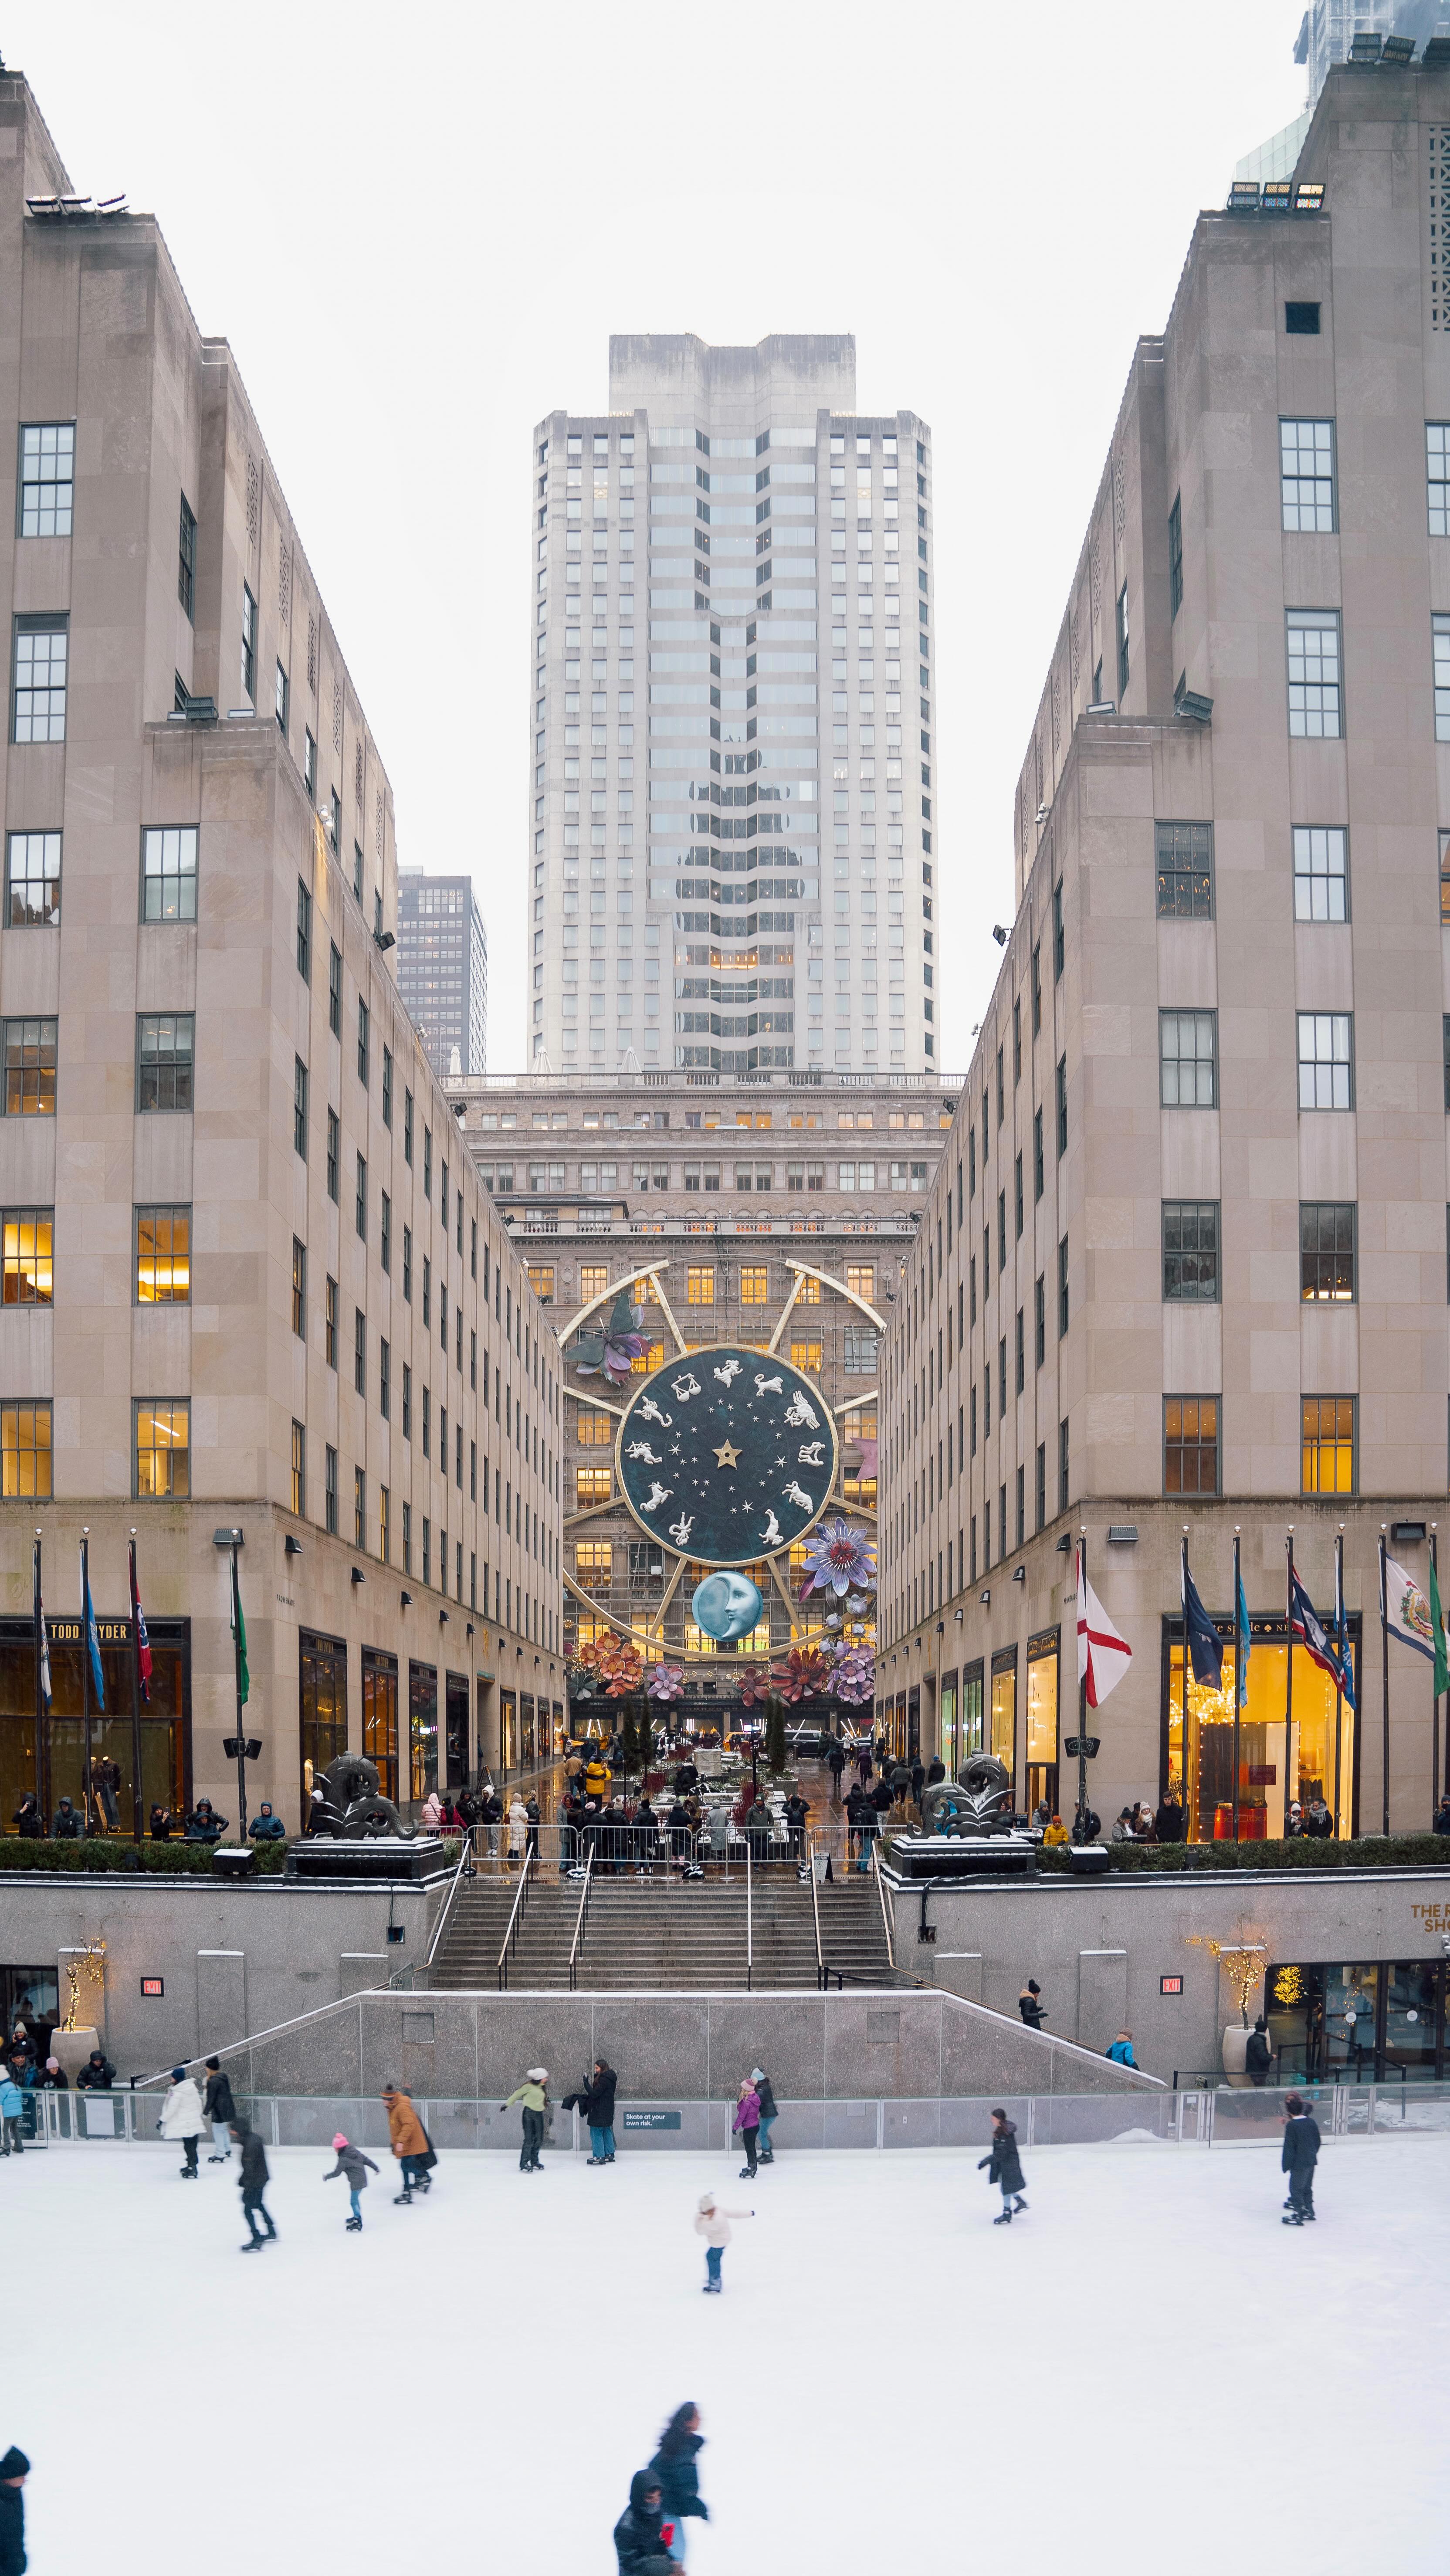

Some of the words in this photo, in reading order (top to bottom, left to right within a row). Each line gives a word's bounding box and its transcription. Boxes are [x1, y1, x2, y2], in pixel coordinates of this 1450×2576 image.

[51, 1625, 79, 1639] TODD
[95, 1625, 126, 1639] YDER
[1411, 1904, 1441, 1918] THE
[145, 1981, 161, 1993] EXIT
[1164, 1979, 1180, 1991] EXIT
